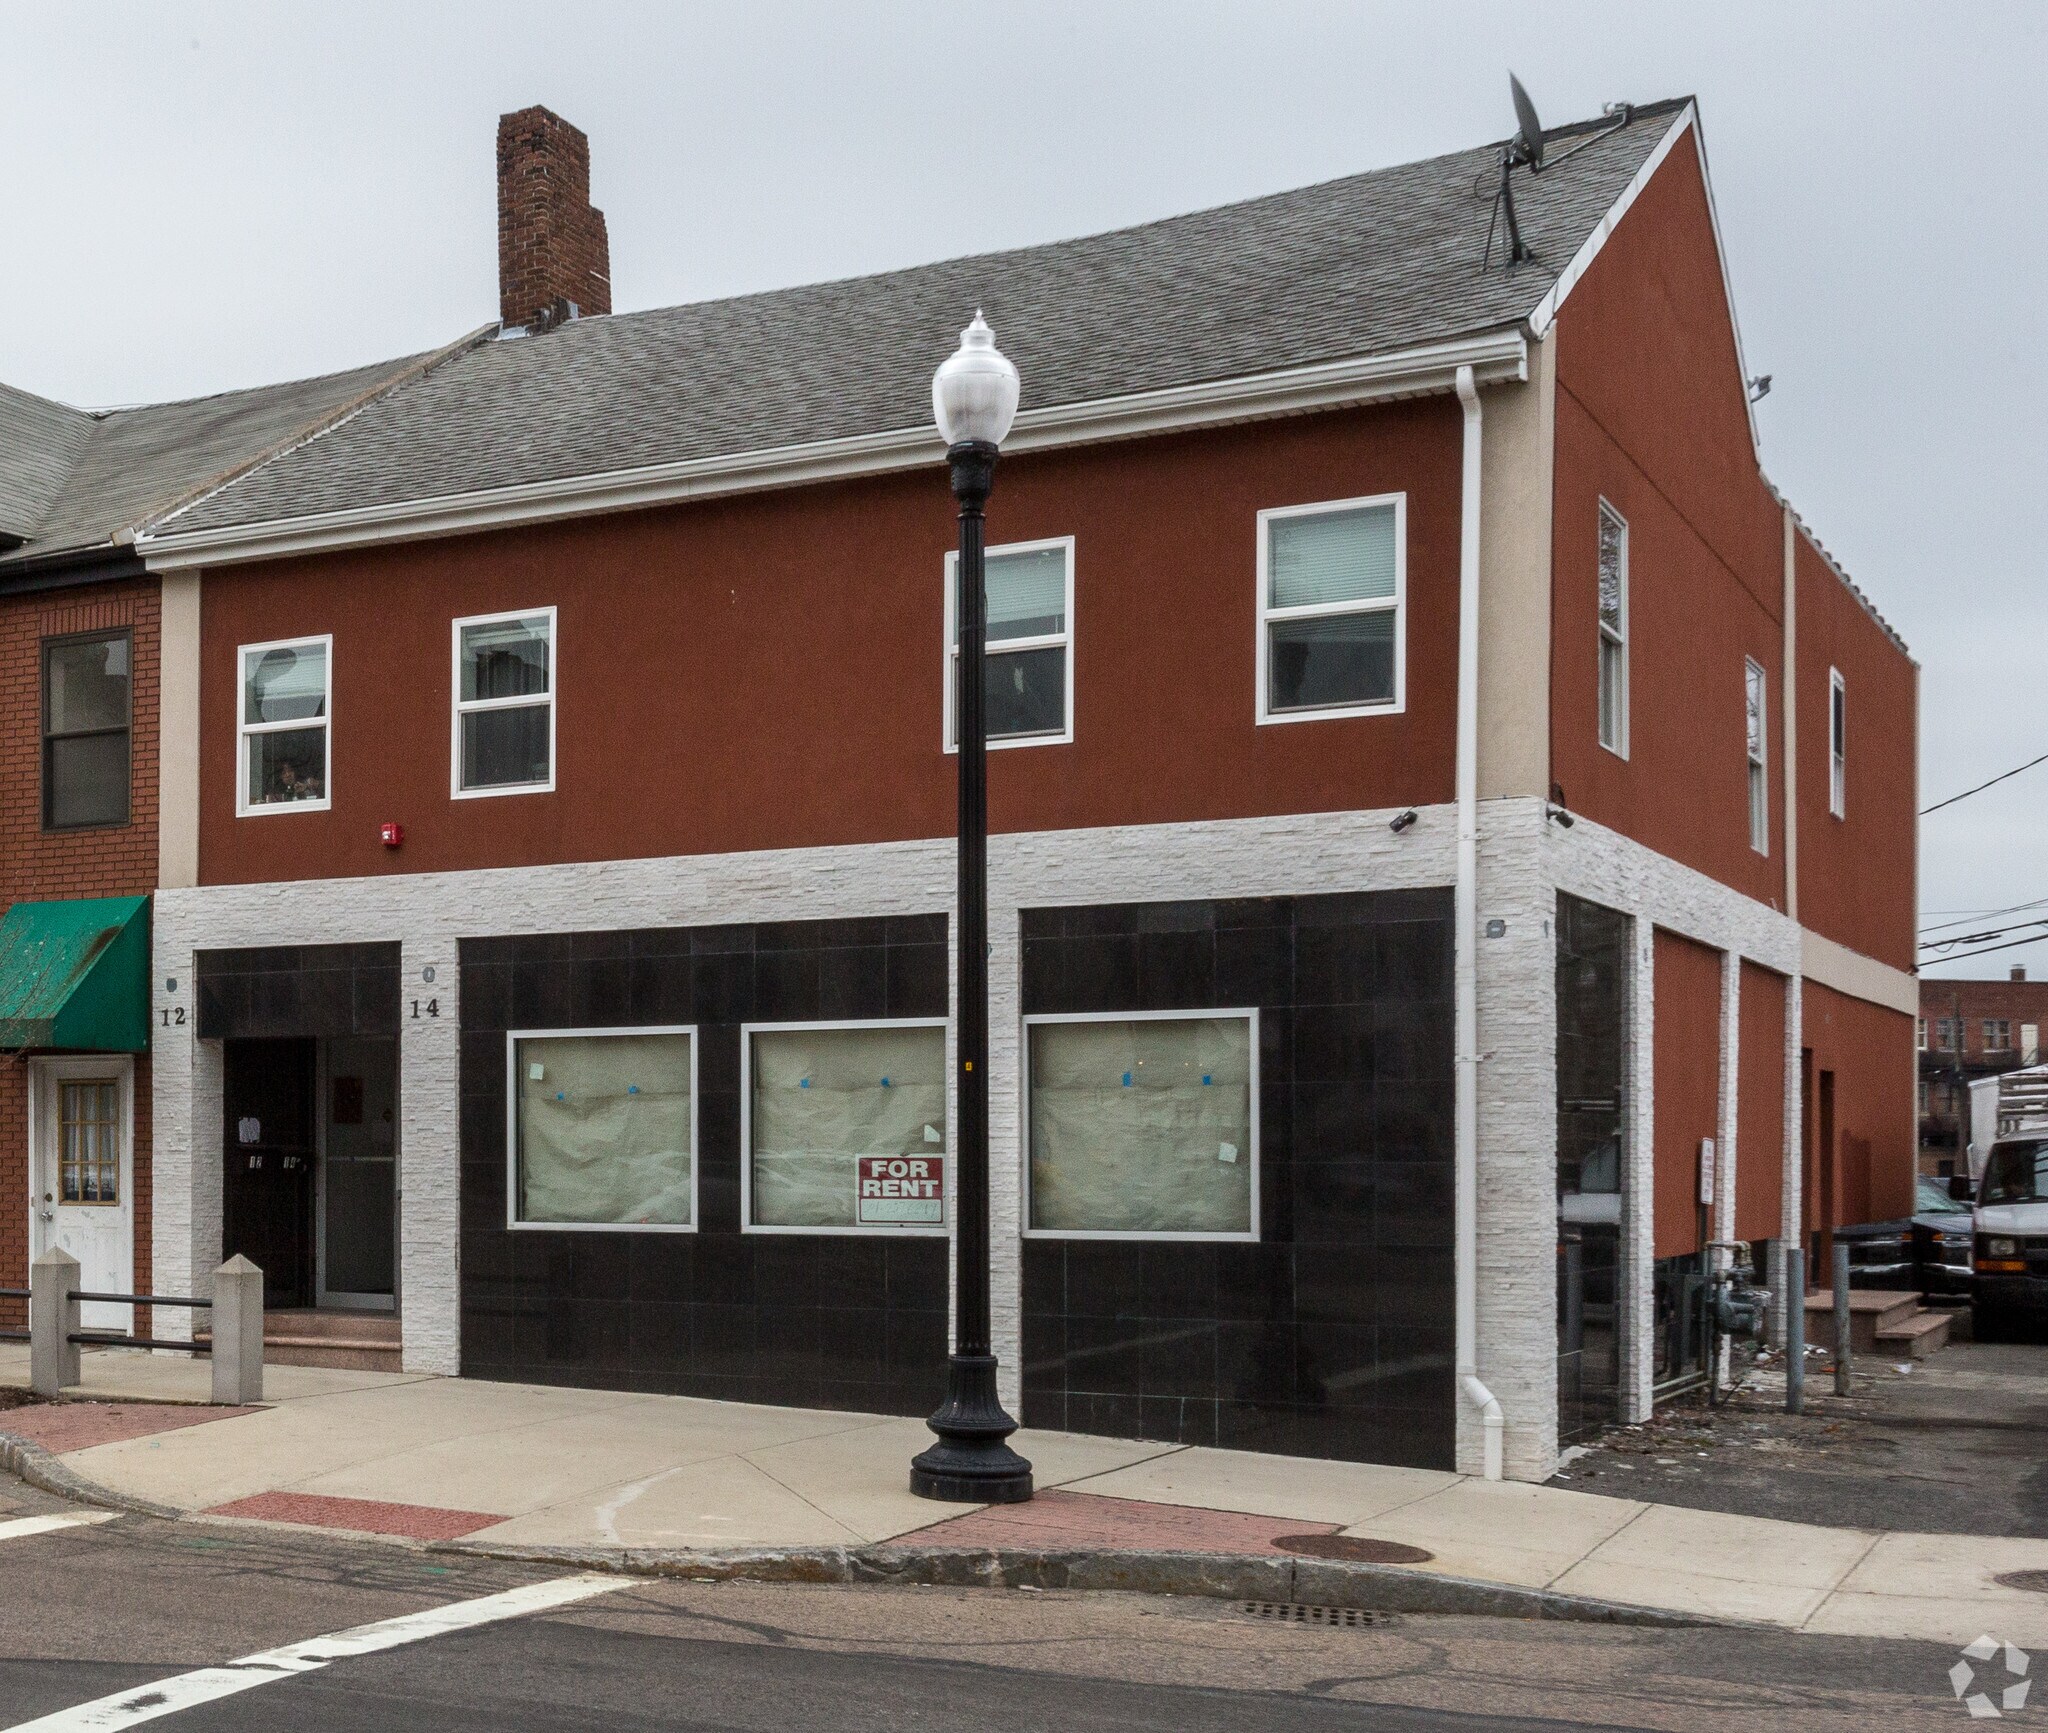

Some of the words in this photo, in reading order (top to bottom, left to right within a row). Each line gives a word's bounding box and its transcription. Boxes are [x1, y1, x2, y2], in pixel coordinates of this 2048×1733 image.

[161, 1006, 186, 1027] 12
[410, 998, 440, 1019] 14
[871, 1160, 929, 1178] FOR
[862, 1179, 939, 1197] RENT
